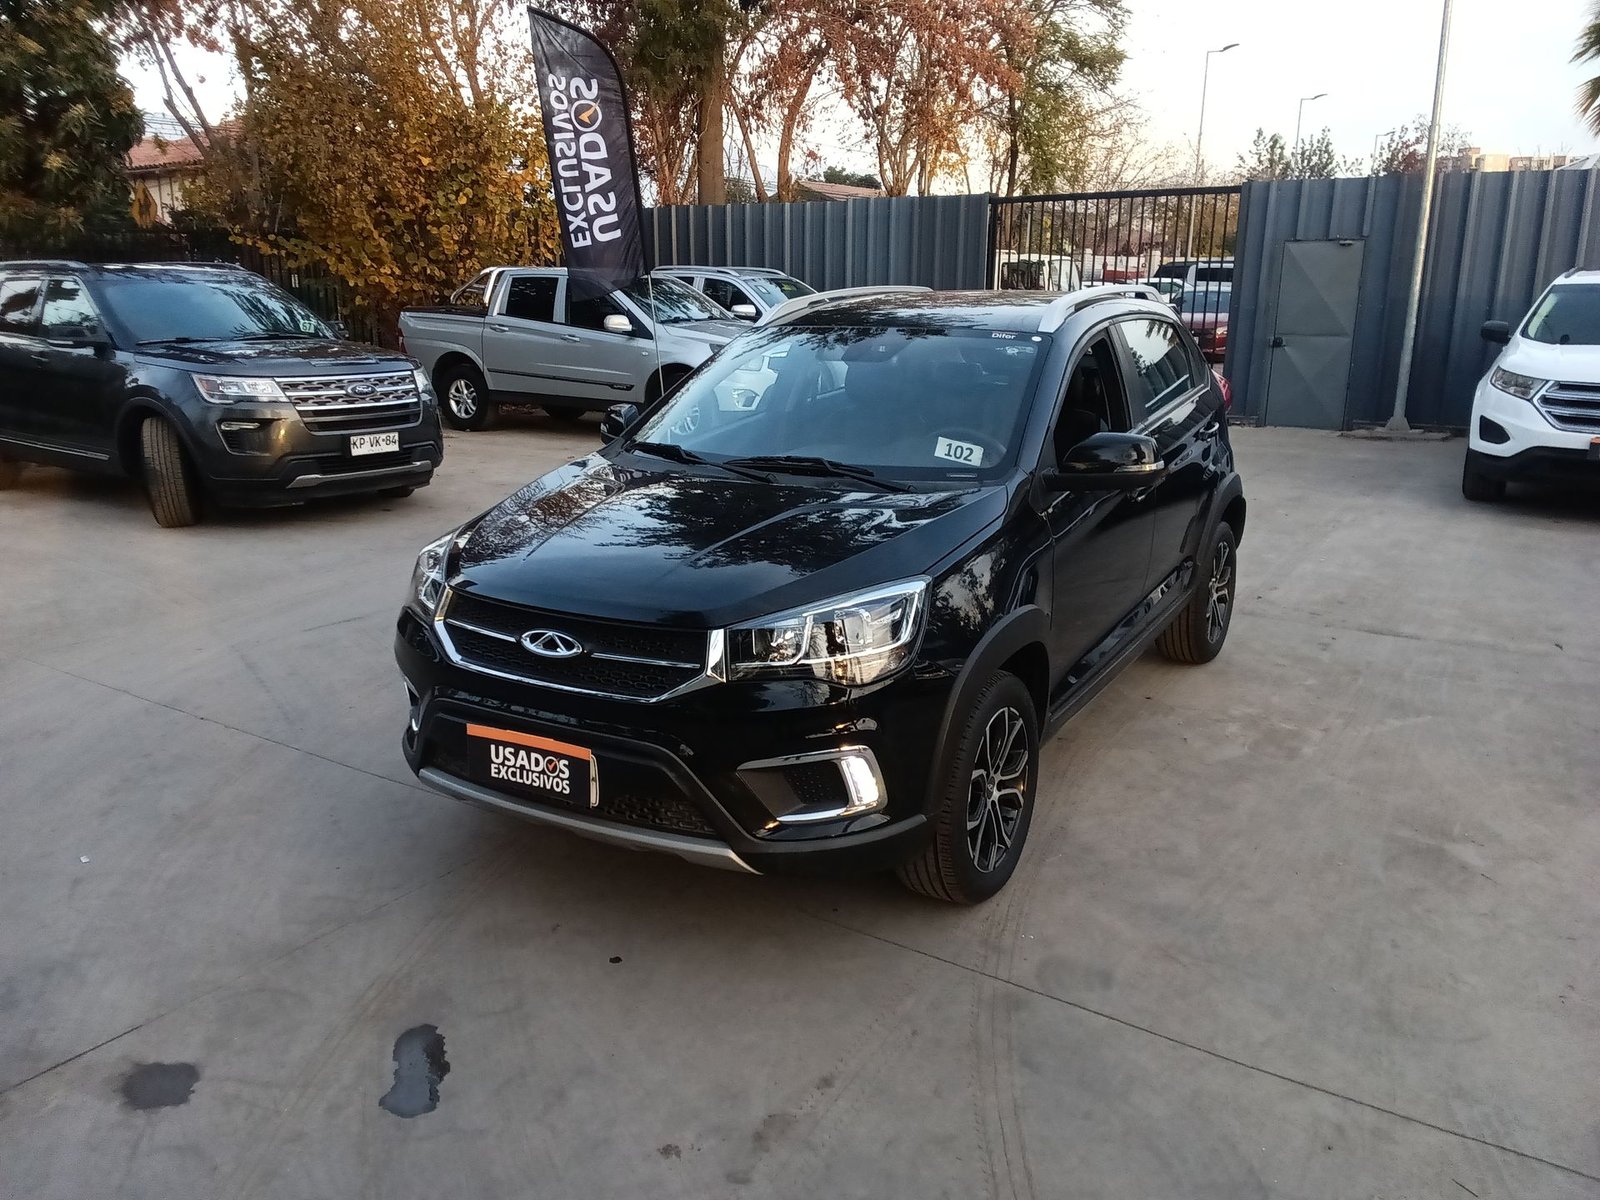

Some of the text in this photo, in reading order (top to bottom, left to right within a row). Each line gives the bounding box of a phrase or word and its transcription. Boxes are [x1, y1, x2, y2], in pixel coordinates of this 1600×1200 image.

[944, 443, 974, 462] 102
[490, 744, 570, 779] USADOS
[490, 763, 570, 794] EXCLUSIVOS
